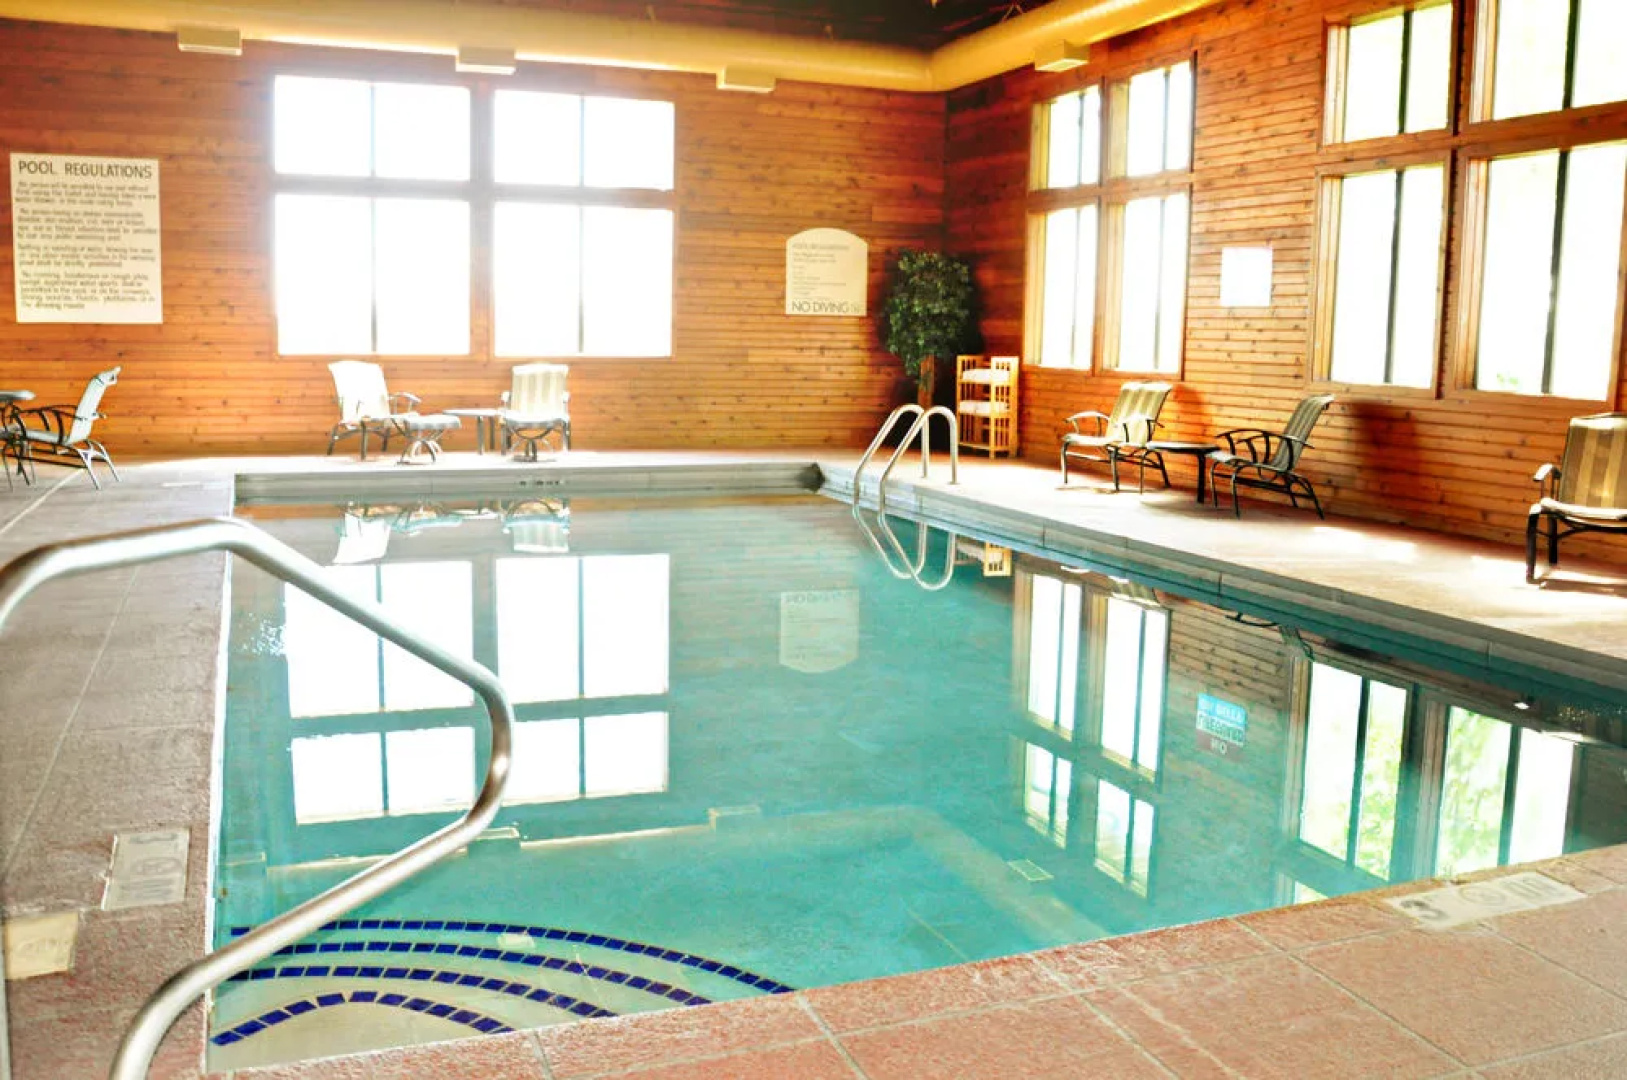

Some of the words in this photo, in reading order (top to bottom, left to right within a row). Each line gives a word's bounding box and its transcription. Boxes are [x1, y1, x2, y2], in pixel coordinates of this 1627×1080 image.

[18, 160, 57, 175] POOL
[64, 162, 152, 180] REGULATIONS
[792, 301, 811, 313] NO
[813, 301, 849, 313] DIVING
